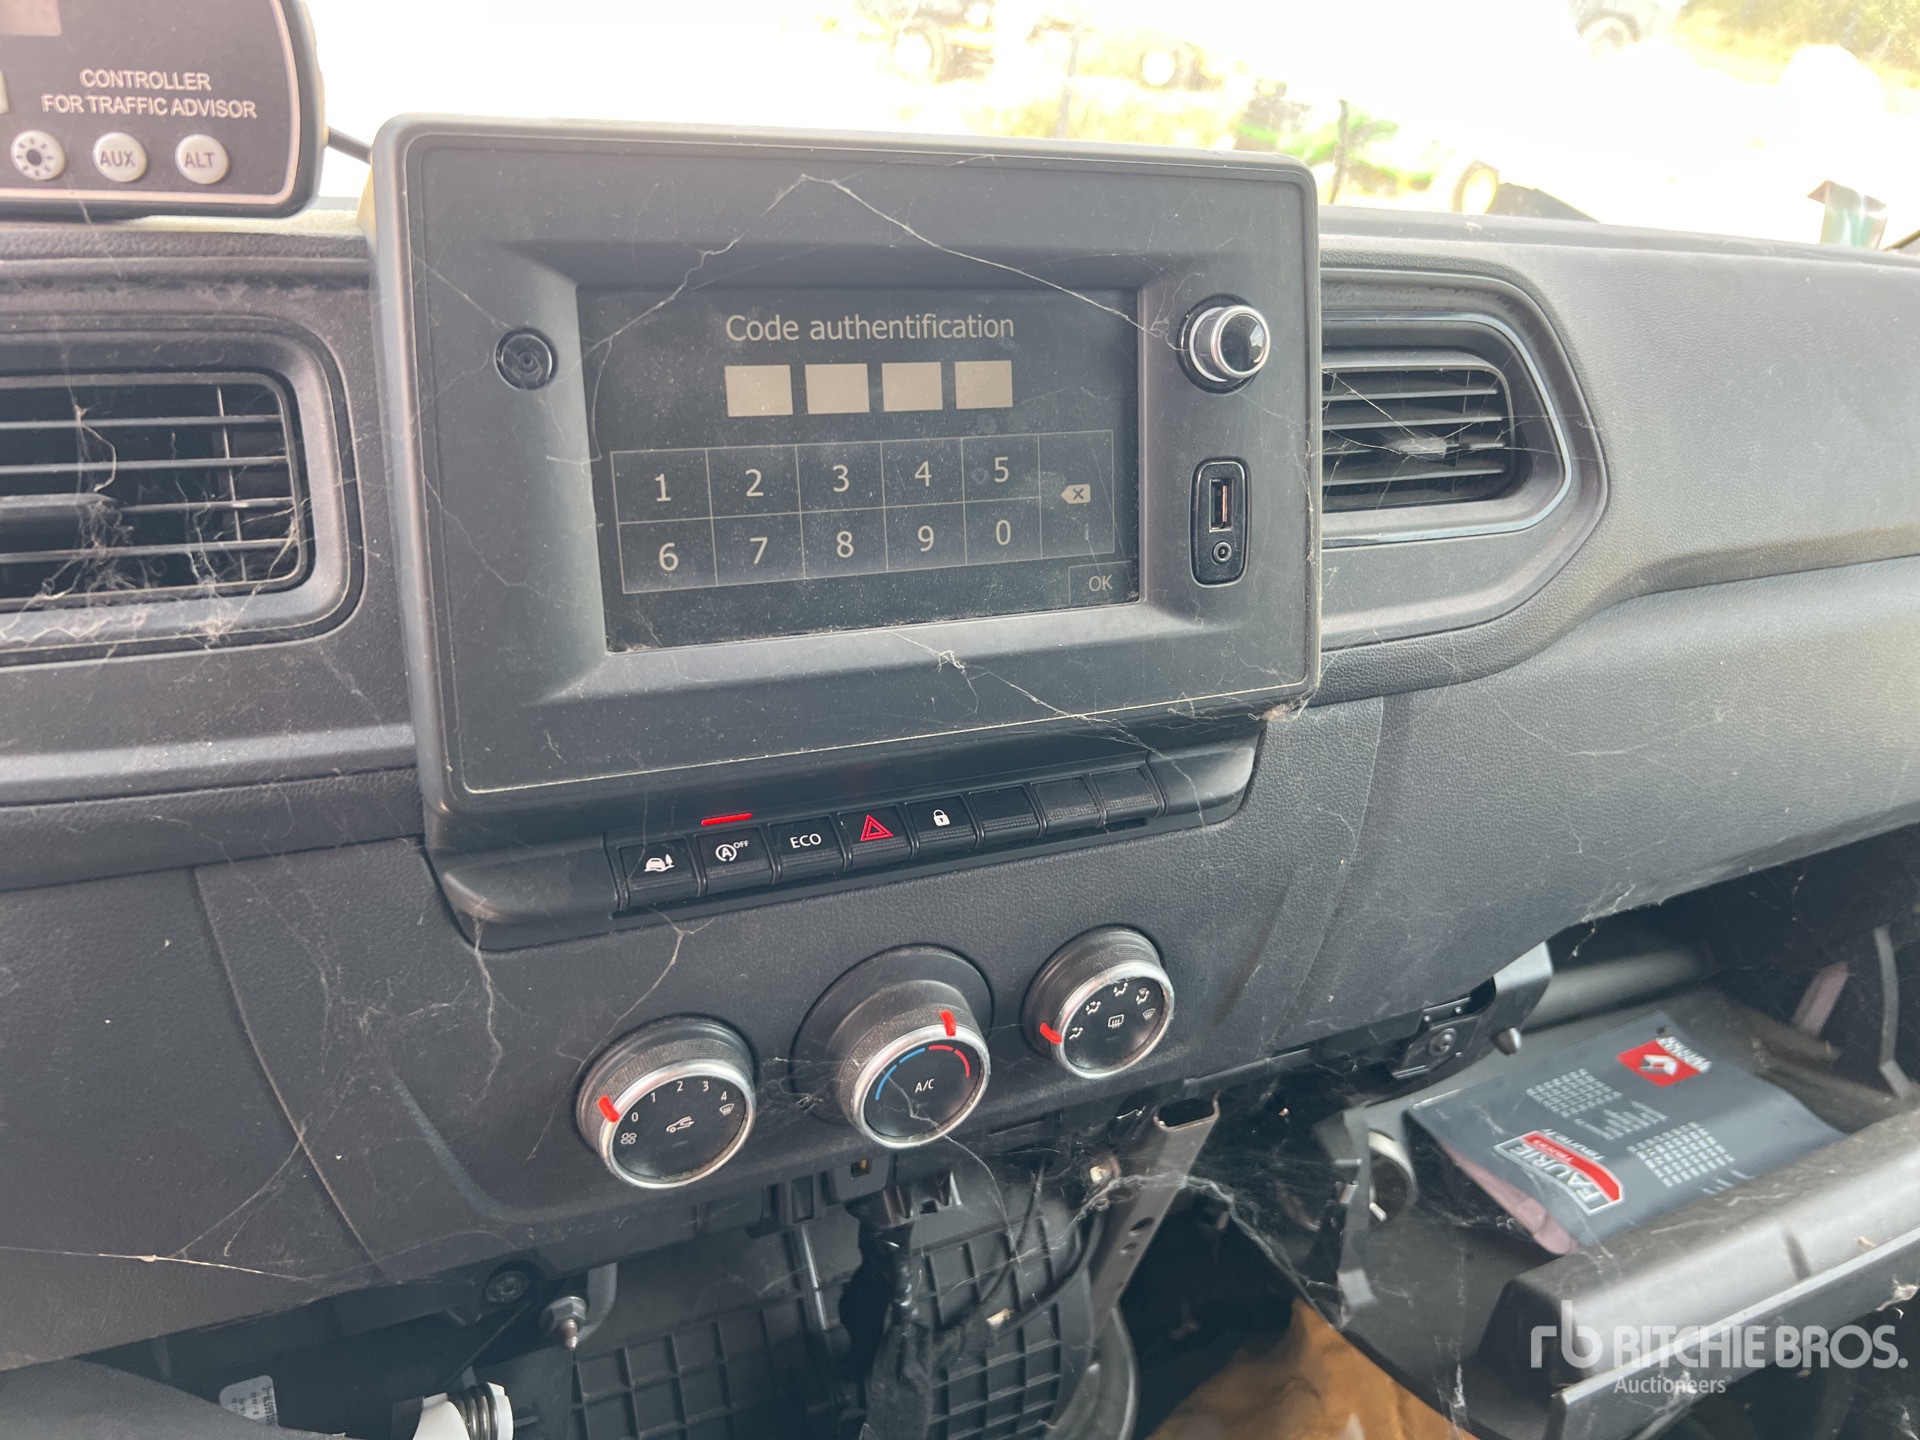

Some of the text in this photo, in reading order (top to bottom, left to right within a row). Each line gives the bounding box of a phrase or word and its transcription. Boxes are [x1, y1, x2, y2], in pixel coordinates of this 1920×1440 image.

[79, 68, 212, 92] CONTROLLER
[41, 94, 258, 119] FOR TRAFFIC ADVISOR
[100, 151, 135, 168] AUX
[184, 152, 215, 169] ALT
[725, 313, 1015, 341] Code authentification
[655, 456, 1009, 502] 1 2 3 4 5
[659, 519, 1011, 571] 6 7 8 9 0
[1088, 575, 1112, 591] OK
[733, 840, 750, 849] OFF
[790, 833, 822, 849] ECO
[914, 1078, 935, 1093] A/C
[631, 1080, 728, 1122] 0 1 2 3 4
[1508, 1143, 1602, 1203] FAURIE
